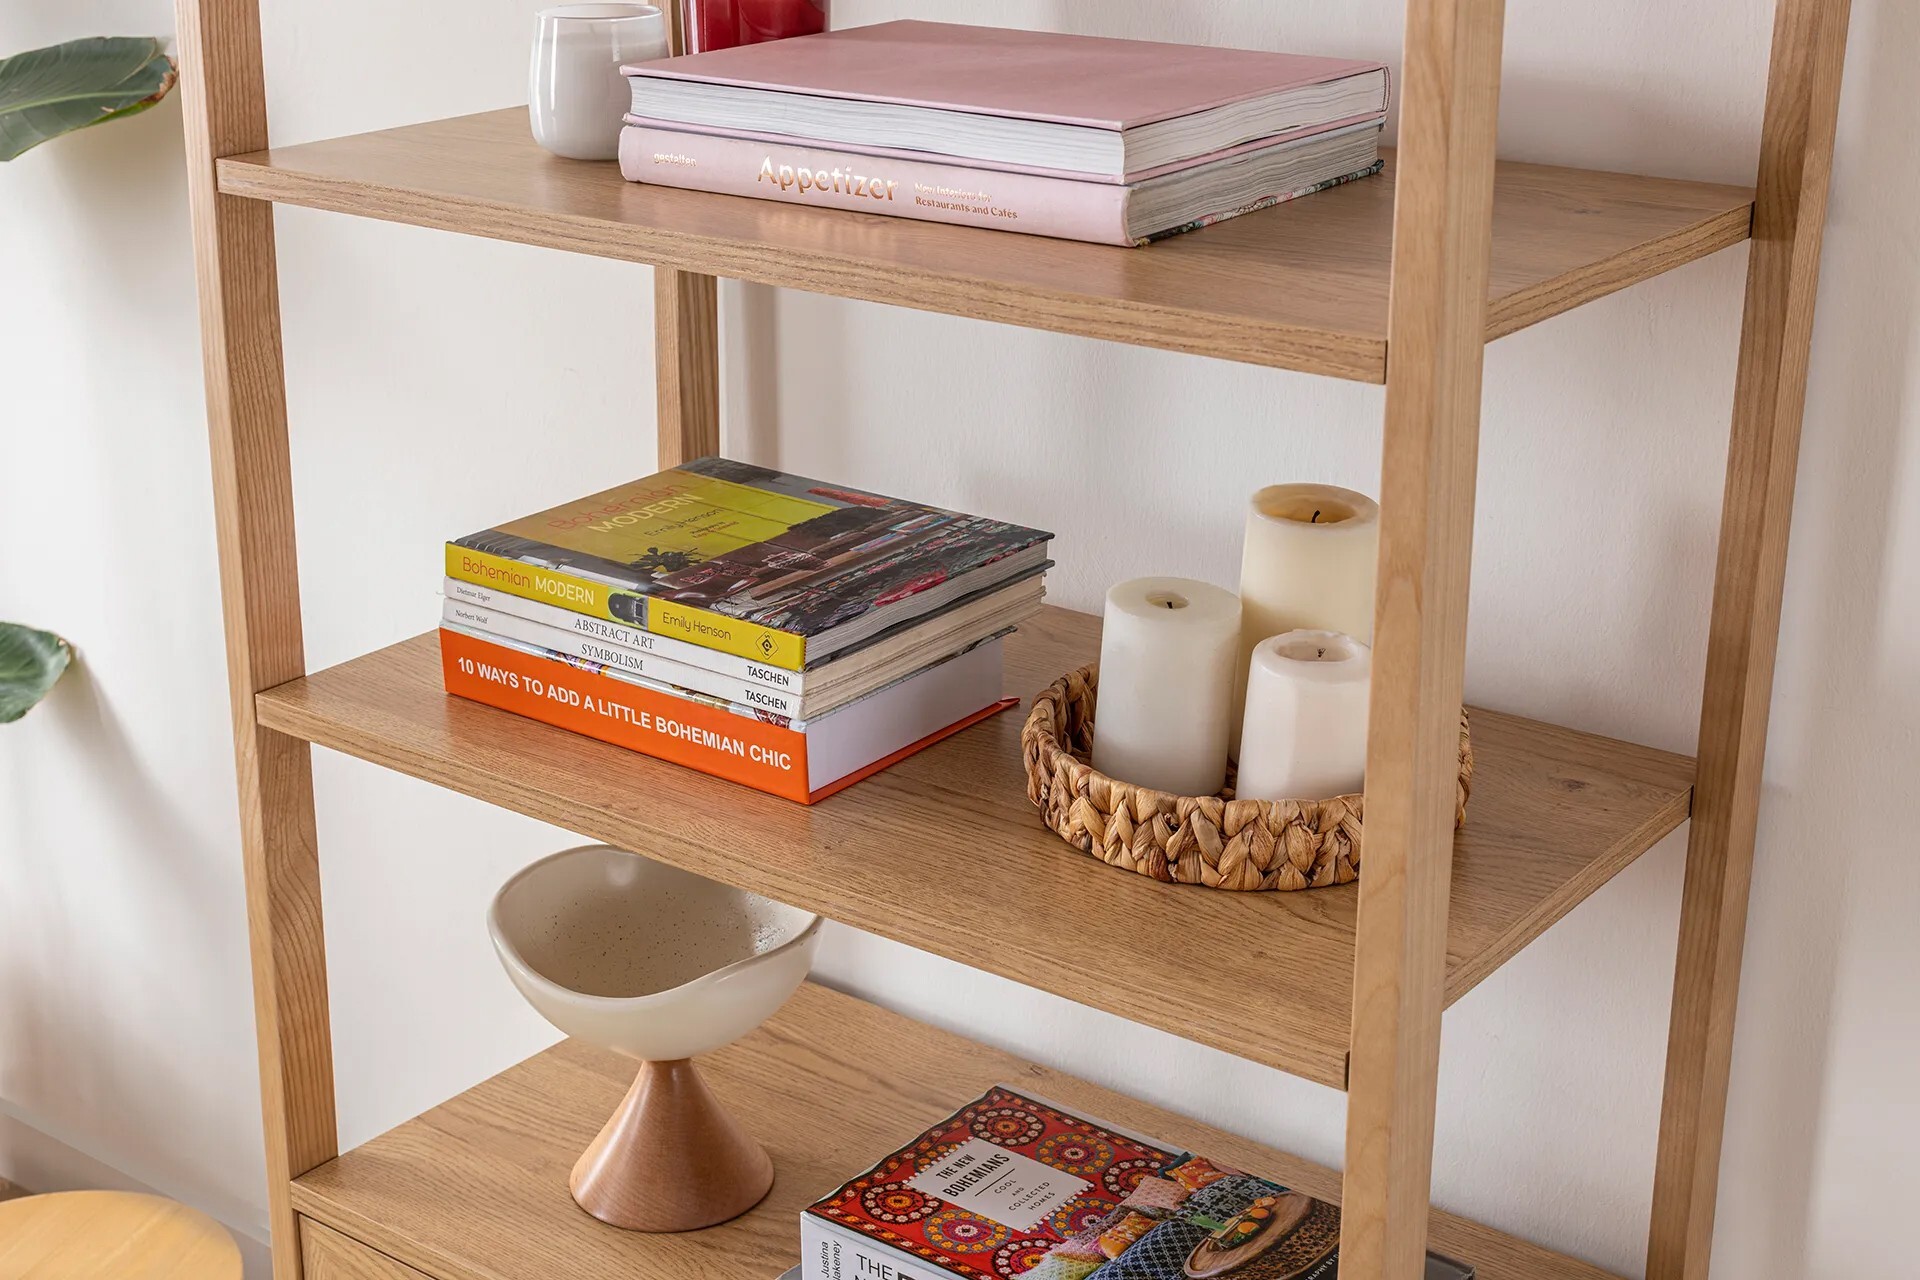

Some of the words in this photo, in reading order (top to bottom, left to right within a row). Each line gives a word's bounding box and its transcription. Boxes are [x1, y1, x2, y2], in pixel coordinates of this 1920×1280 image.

[653, 152, 697, 168] gestalten
[757, 155, 899, 201] Appetizer
[914, 182, 934, 196] New
[937, 185, 976, 201] Interiors
[978, 190, 993, 203] for
[915, 195, 971, 213] Restaurants
[972, 205, 989, 216] and
[990, 206, 1018, 219] Cafés
[547, 484, 689, 531] Bohemian
[587, 493, 705, 533] MODERN
[456, 586, 477, 598] Dietmar
[477, 591, 491, 602] Elger
[462, 556, 531, 589] Bohemian
[535, 575, 595, 606] MODERN
[455, 609, 475, 621] Norbert
[475, 615, 489, 624] Wolf
[662, 611, 692, 632] Emily
[693, 622, 732, 641] Henson
[574, 618, 631, 643] ABSTRACT
[632, 635, 655, 649] ART
[581, 643, 644, 671] SYMBOLISM
[747, 665, 789, 687] TASCHEN
[458, 656, 475, 675] 10
[476, 662, 519, 689] WAYS
[522, 675, 544, 696] TO
[547, 684, 580, 707] ADD
[583, 695, 596, 713] A
[598, 699, 652, 729] LITTLE
[655, 715, 745, 757] BOHEMIAN
[749, 744, 792, 771] CHIC
[745, 689, 787, 711] TASCHEN
[935, 1166, 958, 1180] THE
[953, 1153, 976, 1169] NEW
[942, 1153, 1010, 1197] BOHEMIANS
[994, 1179, 1017, 1194] COOL
[1008, 1181, 1050, 1211] COLLECTED
[1011, 1186, 1025, 1197] AND
[1027, 1191, 1056, 1211] HOMES
[820, 1241, 829, 1278] Justina
[832, 1240, 842, 1280] lakeney
[856, 1253, 893, 1280] THE
[1305, 1264, 1328, 1280] RAPHY
